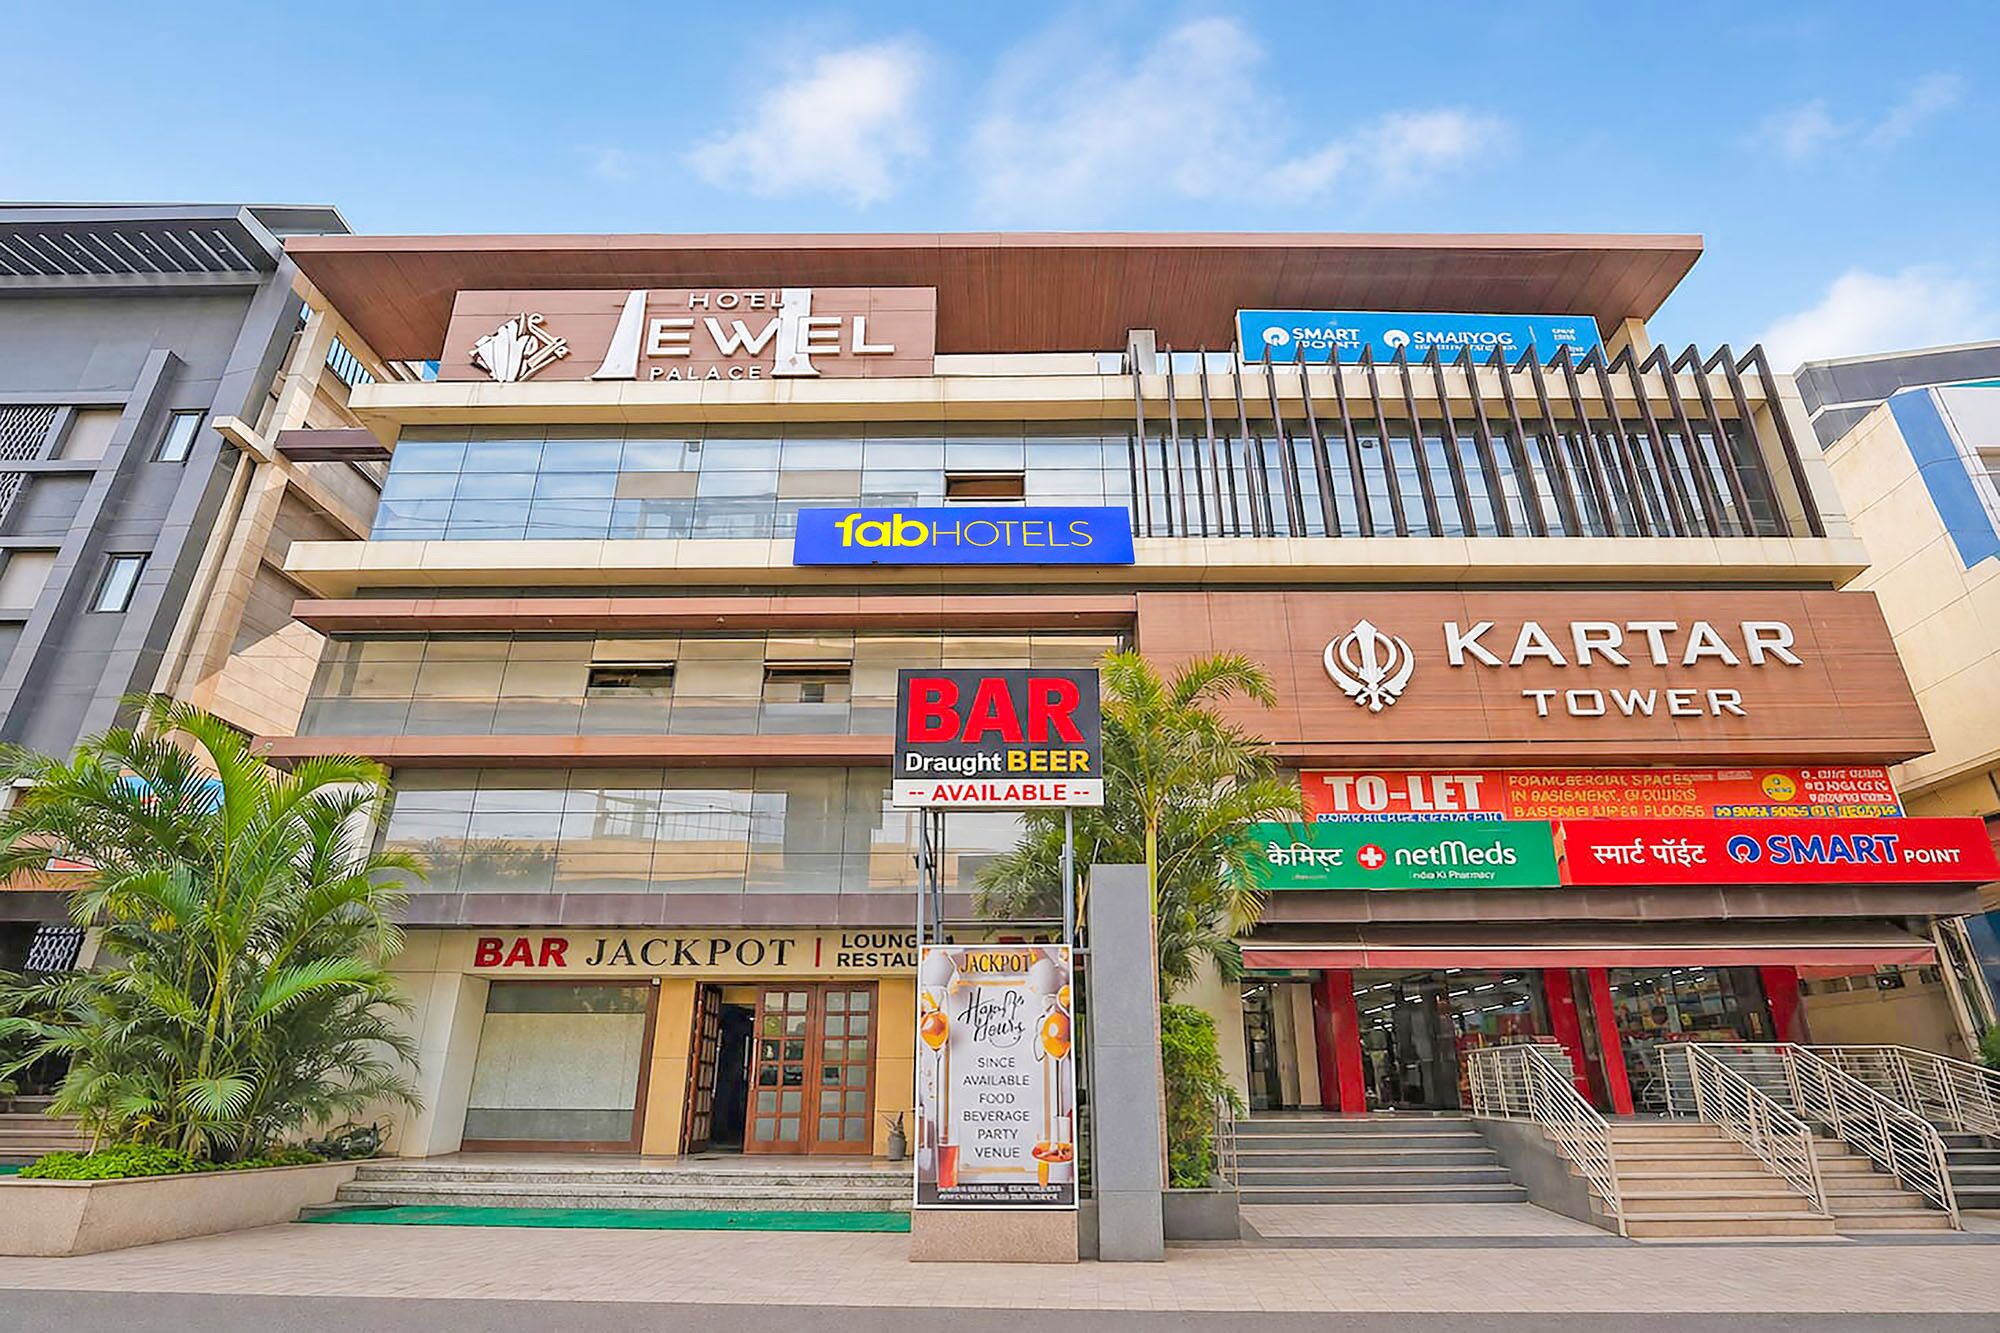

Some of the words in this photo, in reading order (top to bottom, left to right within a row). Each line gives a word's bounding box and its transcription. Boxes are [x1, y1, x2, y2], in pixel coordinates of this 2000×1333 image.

[689, 291, 784, 309] HOTEL
[1292, 327, 1360, 341] SMART
[650, 366, 761, 380] PALACE
[1443, 621, 1804, 667] KARTAR
[906, 677, 1086, 744] BAR
[1522, 688, 1748, 718] TOWER
[905, 752, 1001, 776] Draught
[1007, 750, 1091, 773] BEER
[931, 784, 1067, 801] AVAILABLE
[1323, 775, 1484, 811] TO-LET
[1395, 840, 1517, 866] netMeds
[1591, 841, 1646, 866] स्मार्ट
[1766, 834, 1901, 865] SMART
[1903, 849, 1961, 864] POINT
[473, 937, 569, 968] BAR
[586, 938, 795, 968] JACKPOT
[960, 953, 1032, 973] JACKPOT
[977, 1057, 1015, 1068] SINCE
[963, 1075, 1030, 1086] AVAILABLE
[979, 1093, 1015, 1104] FOOD
[963, 1111, 1030, 1121] BEVERAGE
[977, 1129, 1018, 1140] PARTY
[974, 1147, 1020, 1158] VENUE
